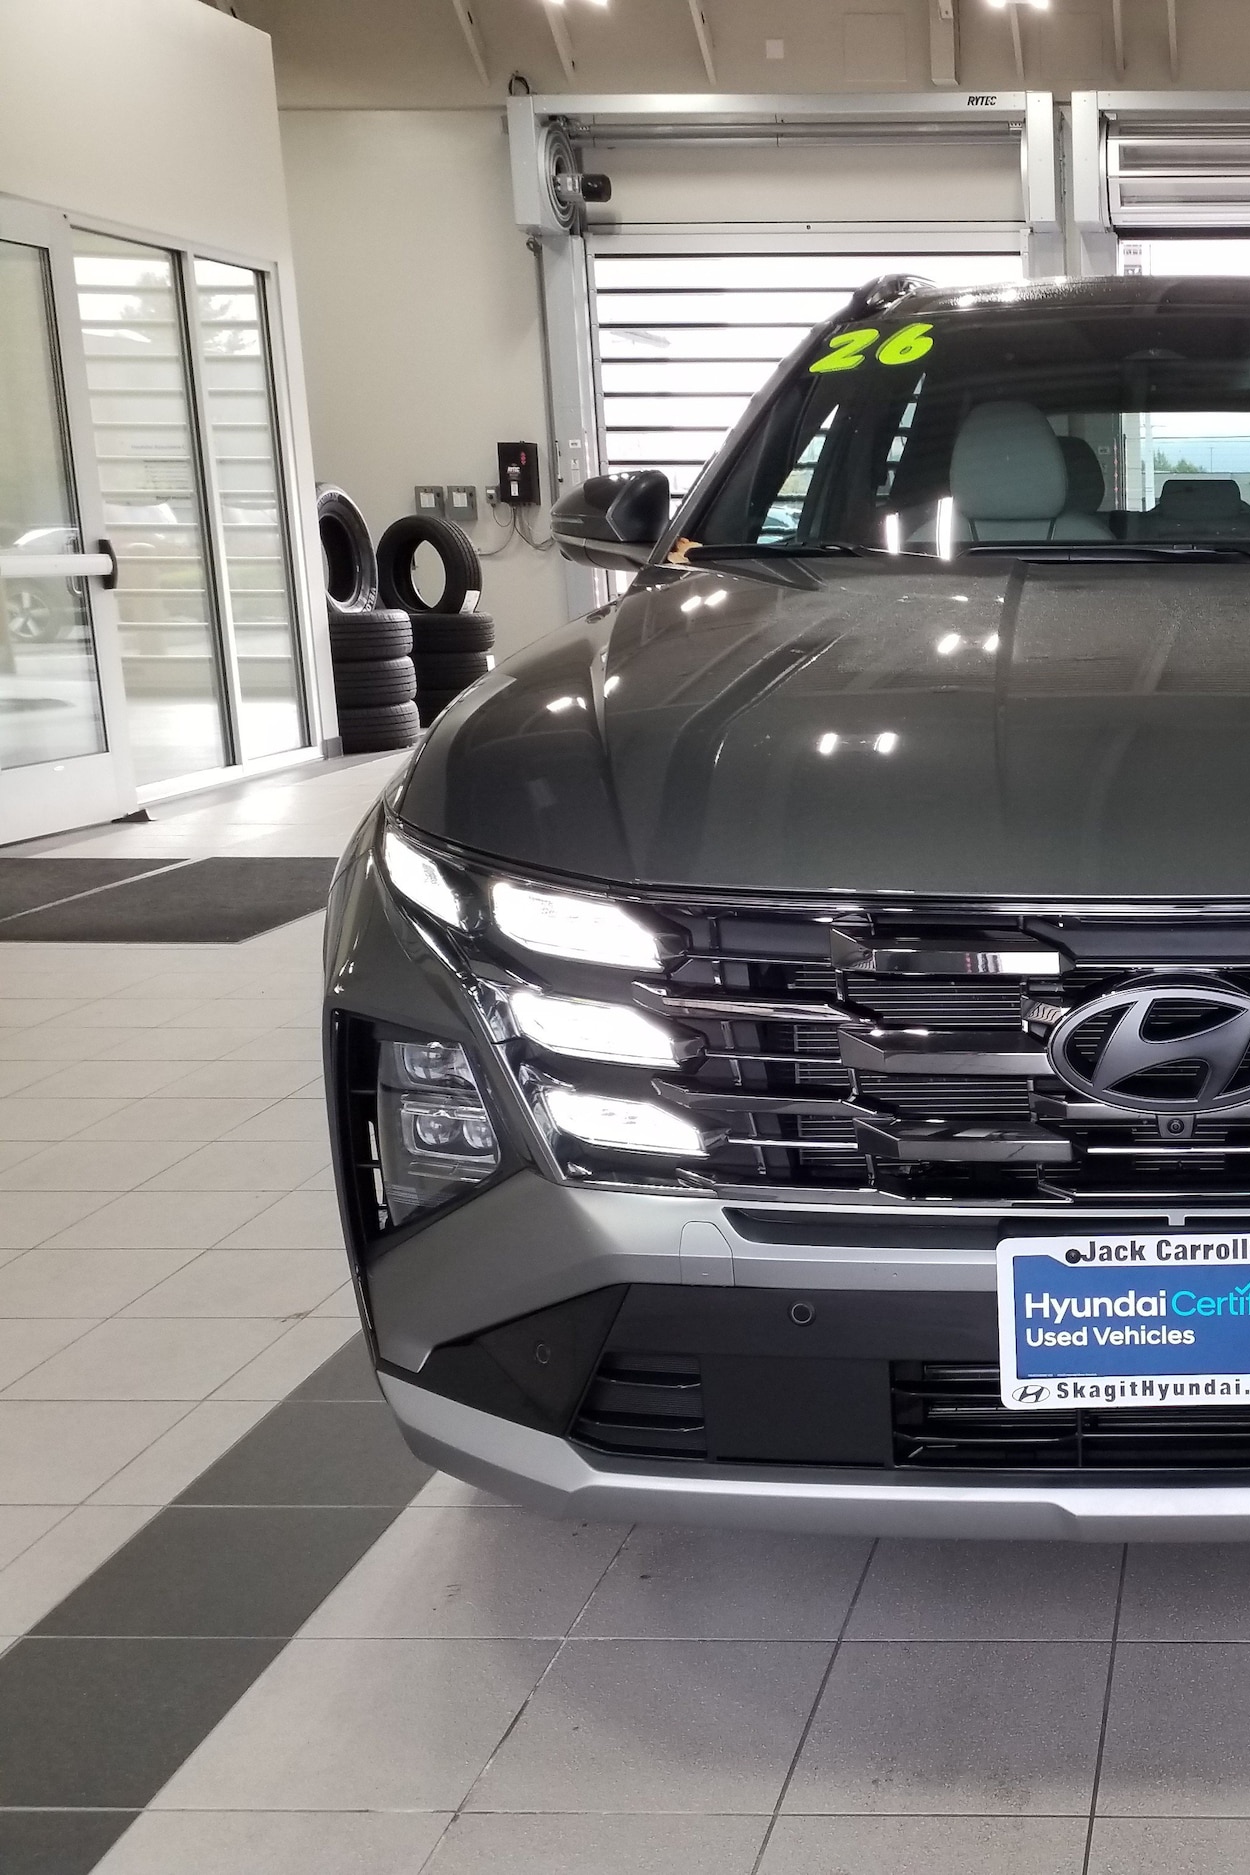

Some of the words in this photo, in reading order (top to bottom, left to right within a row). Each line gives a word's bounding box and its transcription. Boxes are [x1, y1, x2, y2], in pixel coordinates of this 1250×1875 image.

[967, 95, 997, 106] RYTEC
[809, 322, 934, 374] 26
[1081, 1240, 1146, 1262] Jack
[1024, 1290, 1167, 1324] Hyundai
[1026, 1327, 1088, 1348] Used
[1092, 1326, 1196, 1346] Vehicles
